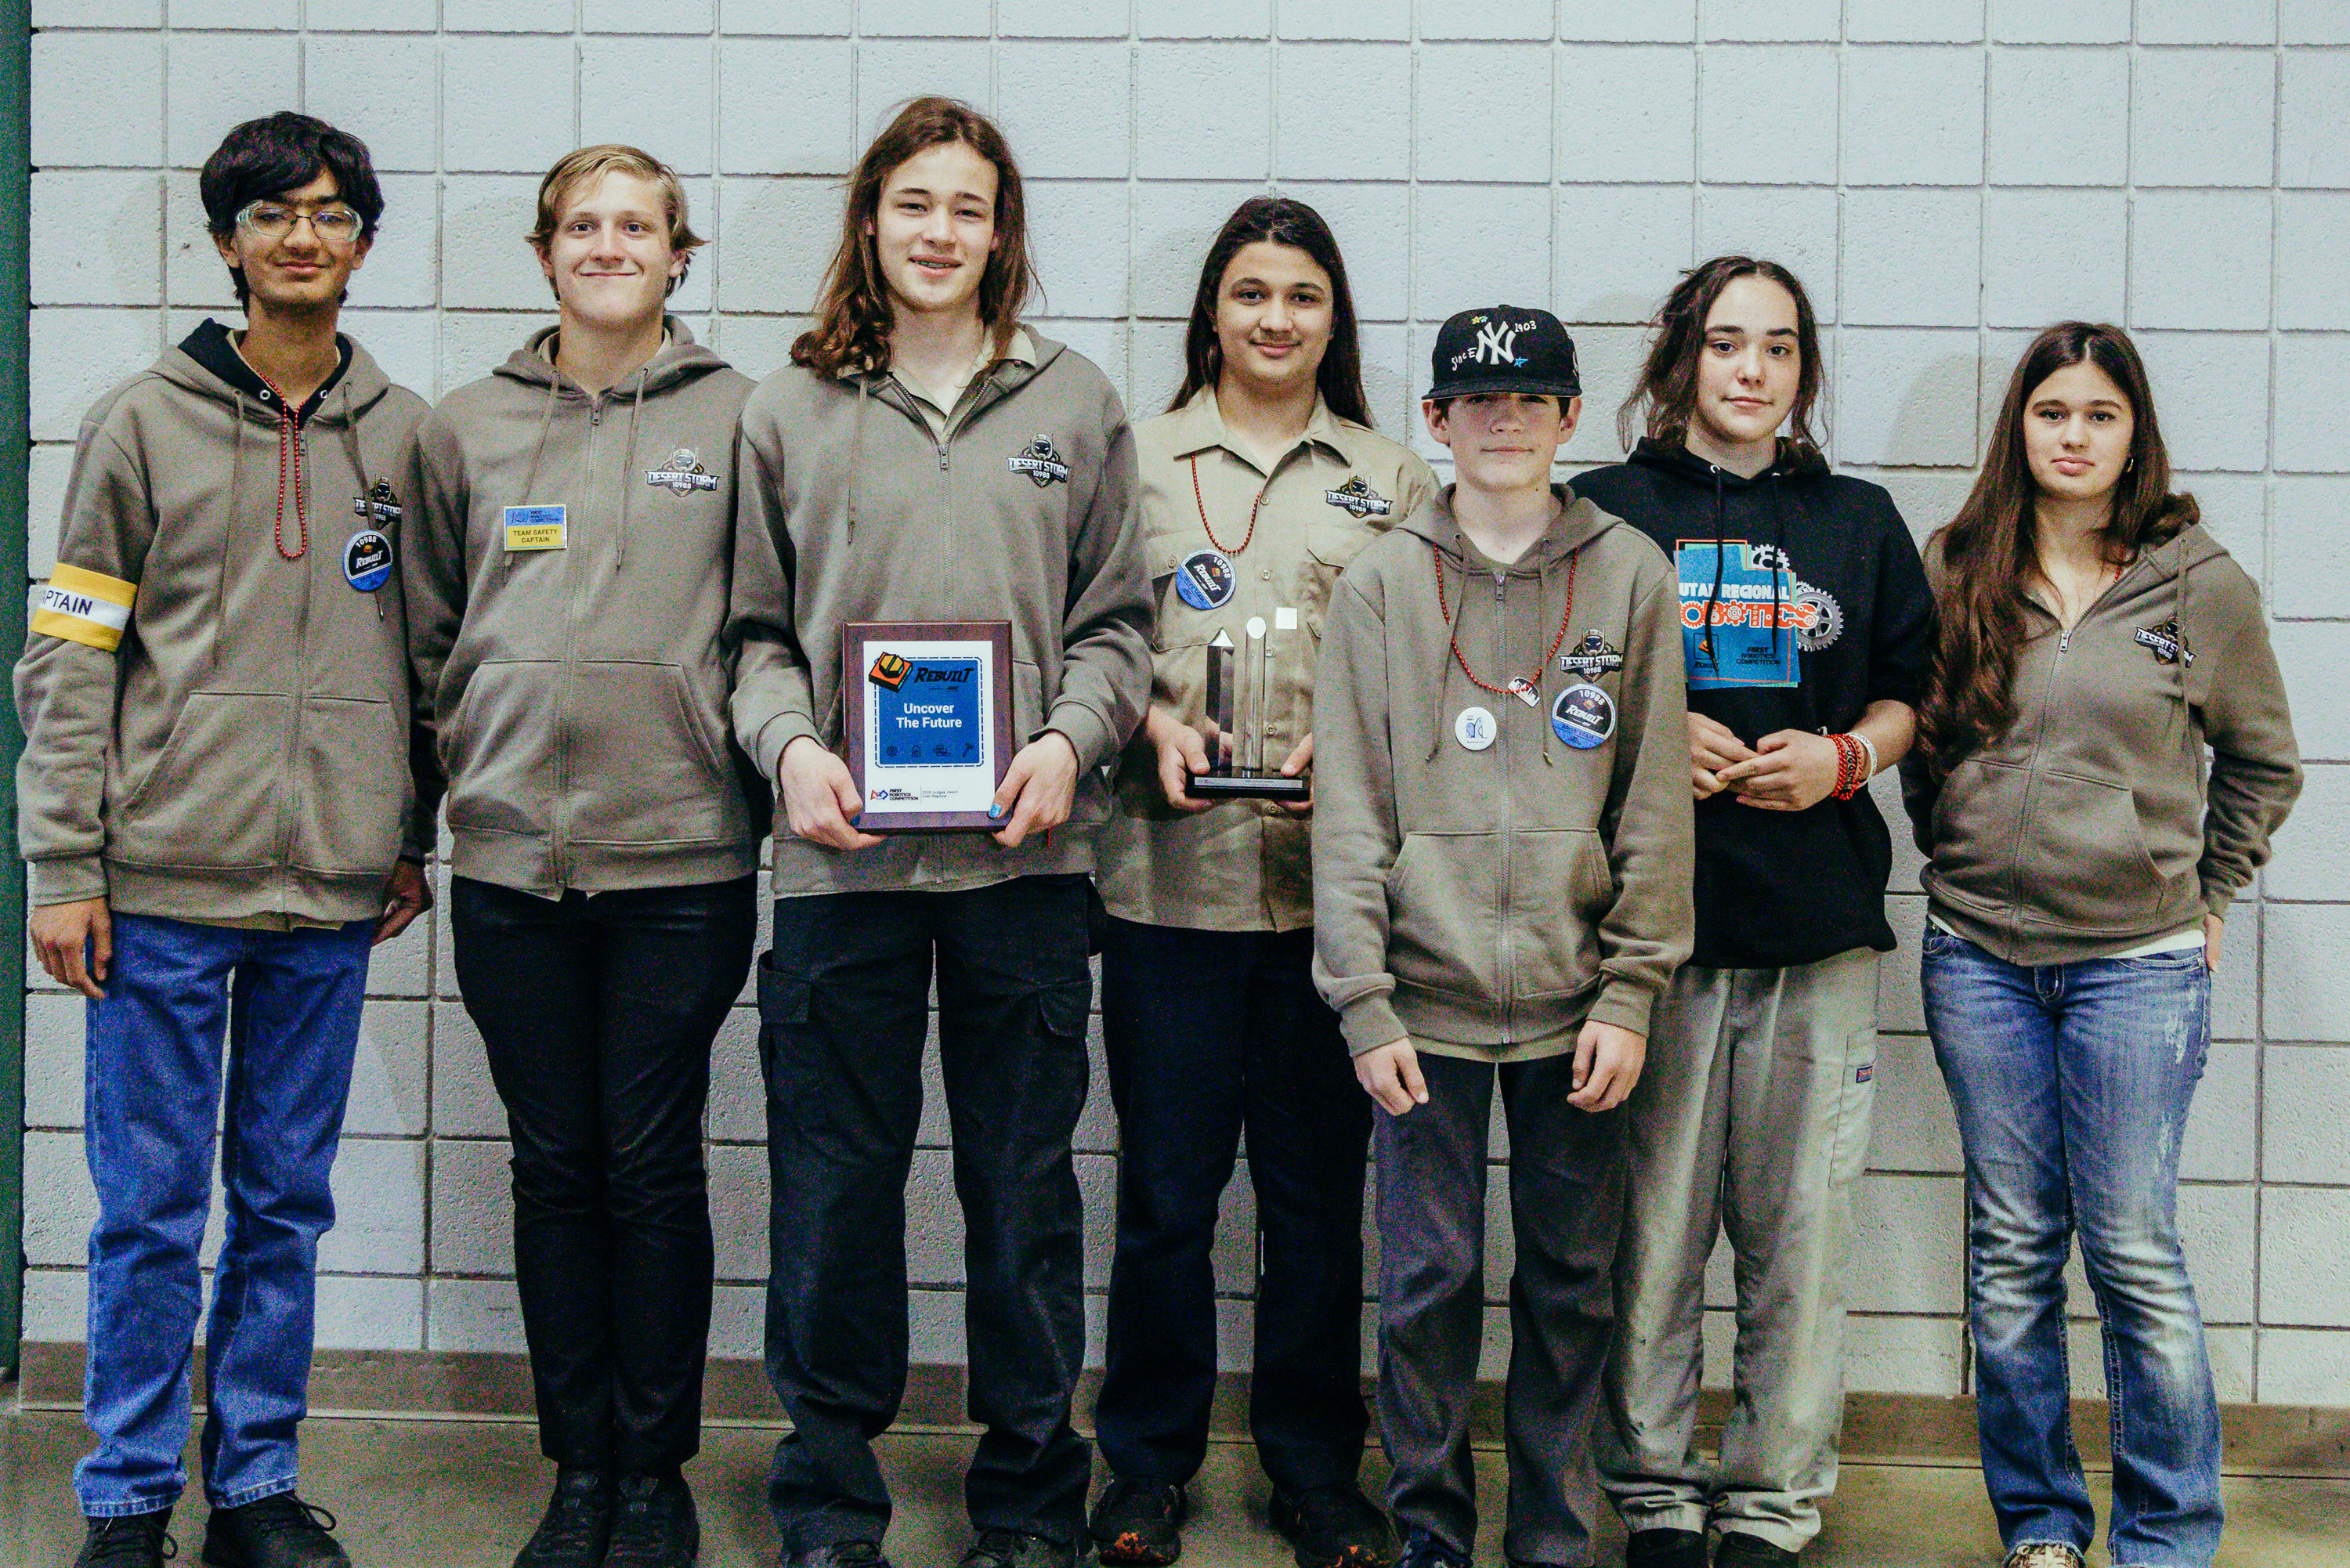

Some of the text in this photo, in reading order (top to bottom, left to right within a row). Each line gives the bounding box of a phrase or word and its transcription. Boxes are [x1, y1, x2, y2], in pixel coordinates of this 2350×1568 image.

[1514, 320, 1537, 332] 1903
[1008, 457, 1069, 479] DESERT STORM
[1033, 470, 1050, 479] 10988
[647, 471, 718, 490] DESERT STORM
[1327, 490, 1391, 514] DESERT STORM
[1350, 504, 1367, 513] 10988
[356, 535, 377, 547] 10988
[1213, 556, 1231, 579] 10988
[1679, 599, 1820, 630] OBOTICS
[2135, 627, 2171, 649] DESERT
[1560, 656, 1595, 670] DESERT
[1583, 666, 1602, 674] 10988
[1579, 689, 1605, 705] 10988
[903, 703, 954, 714] Uncover
[896, 717, 963, 728] The Future
